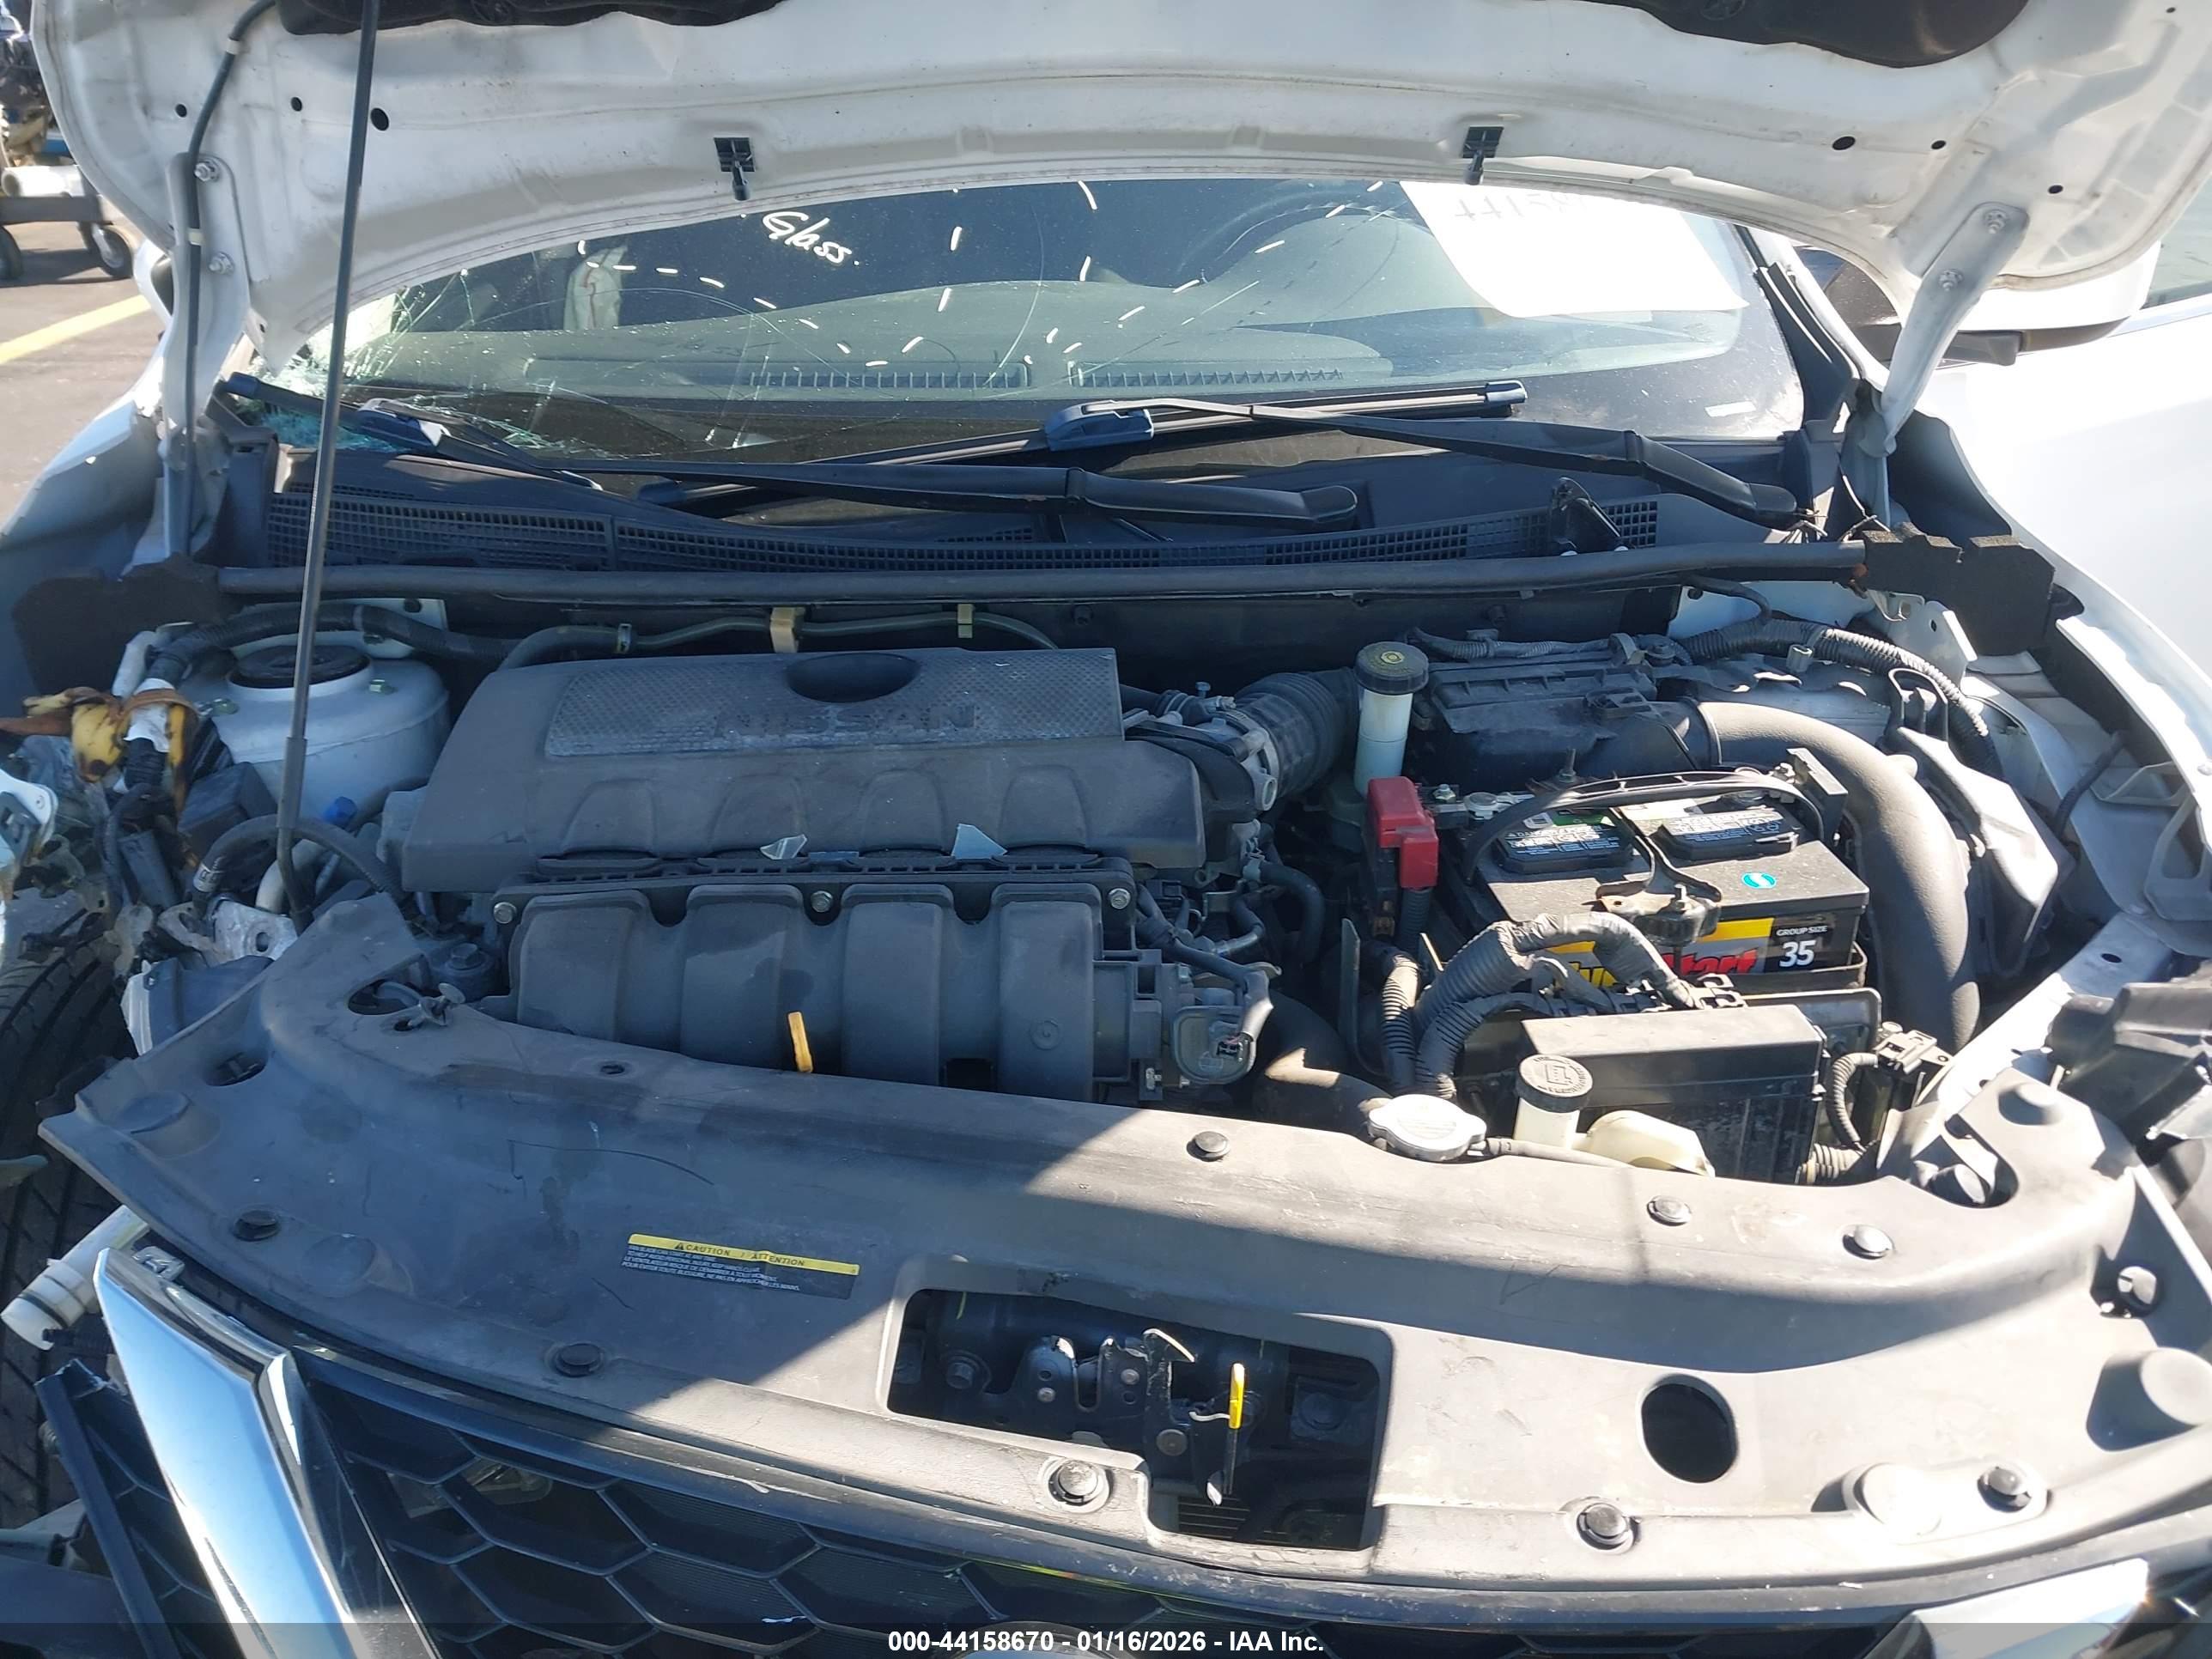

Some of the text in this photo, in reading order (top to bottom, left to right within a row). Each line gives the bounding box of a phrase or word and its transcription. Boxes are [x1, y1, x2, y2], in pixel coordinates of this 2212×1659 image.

[1777, 927, 1808, 936] GROUP
[1779, 939, 1816, 967] 35
[686, 1244, 730, 1256] CAUTION
[750, 1252, 805, 1267] ATTENTION
